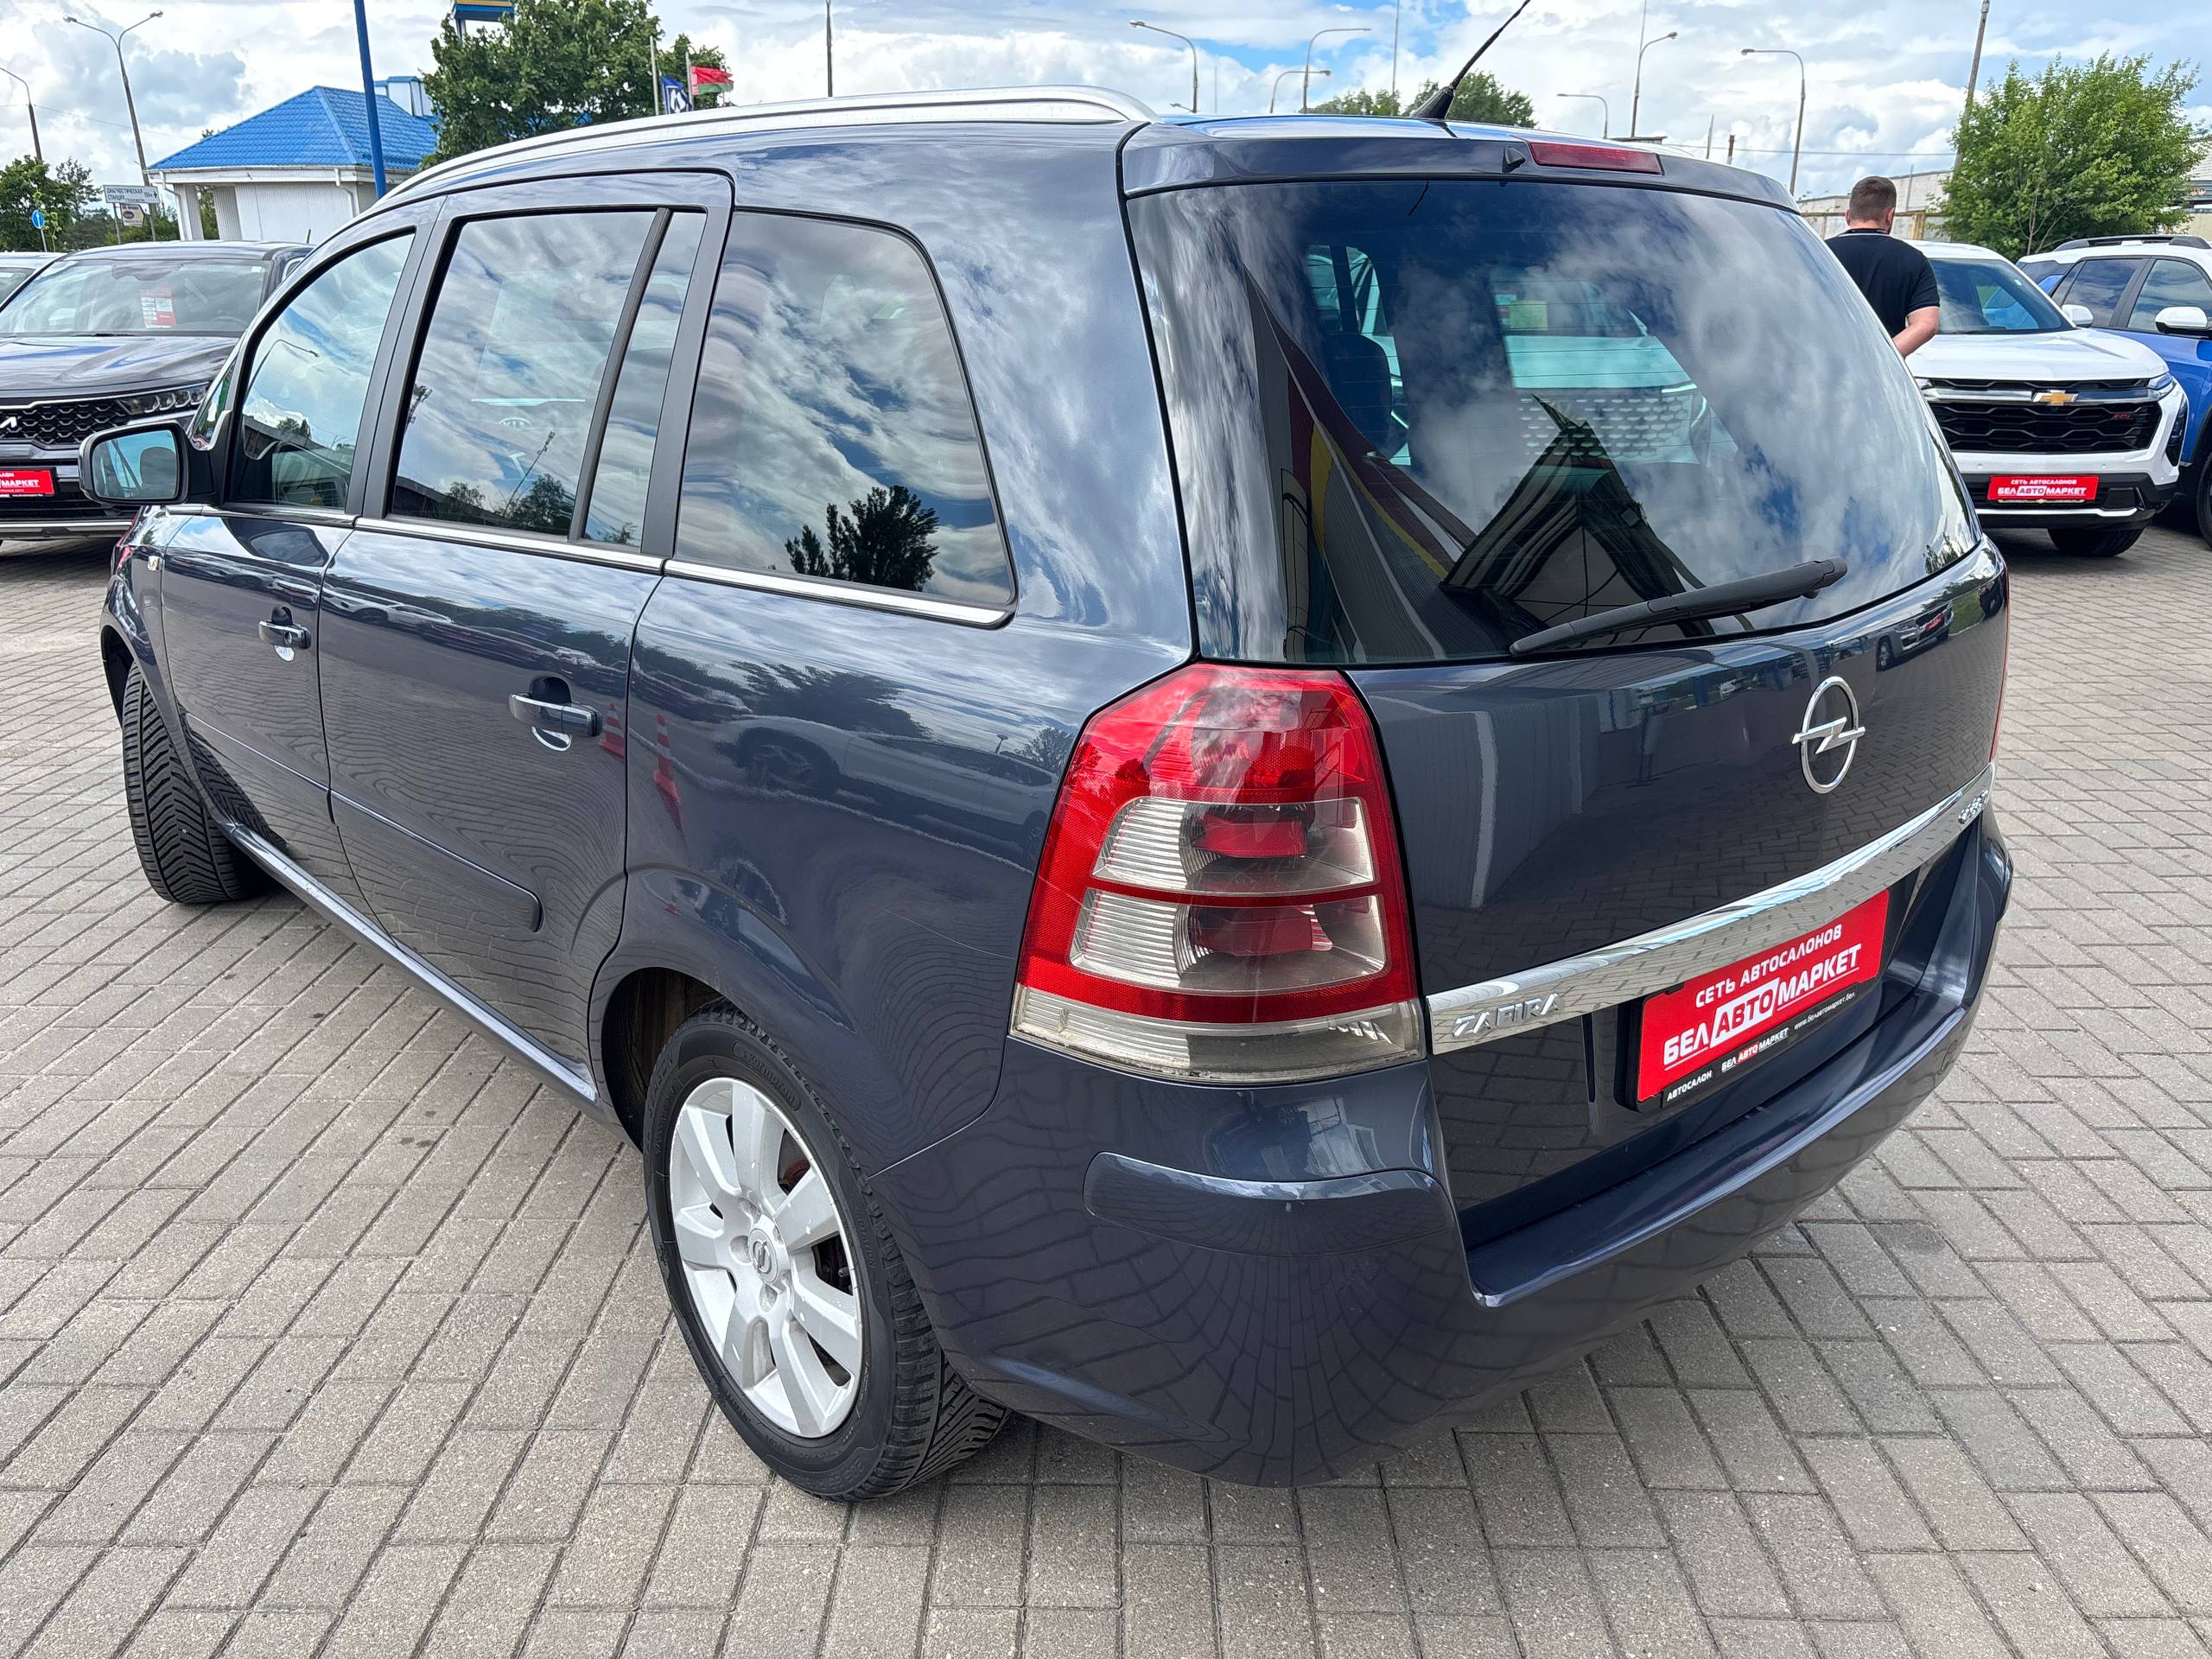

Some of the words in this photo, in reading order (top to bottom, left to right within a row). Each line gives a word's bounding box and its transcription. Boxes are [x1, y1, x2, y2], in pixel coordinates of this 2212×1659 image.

[1695, 977, 1736, 1008] СЕТЬ
[1739, 924, 1843, 985] АВТОСАЛОНОВ
[1452, 993, 1562, 1038] ZAFIRA
[1667, 1070, 1713, 1102] АВТОСАЛОН
